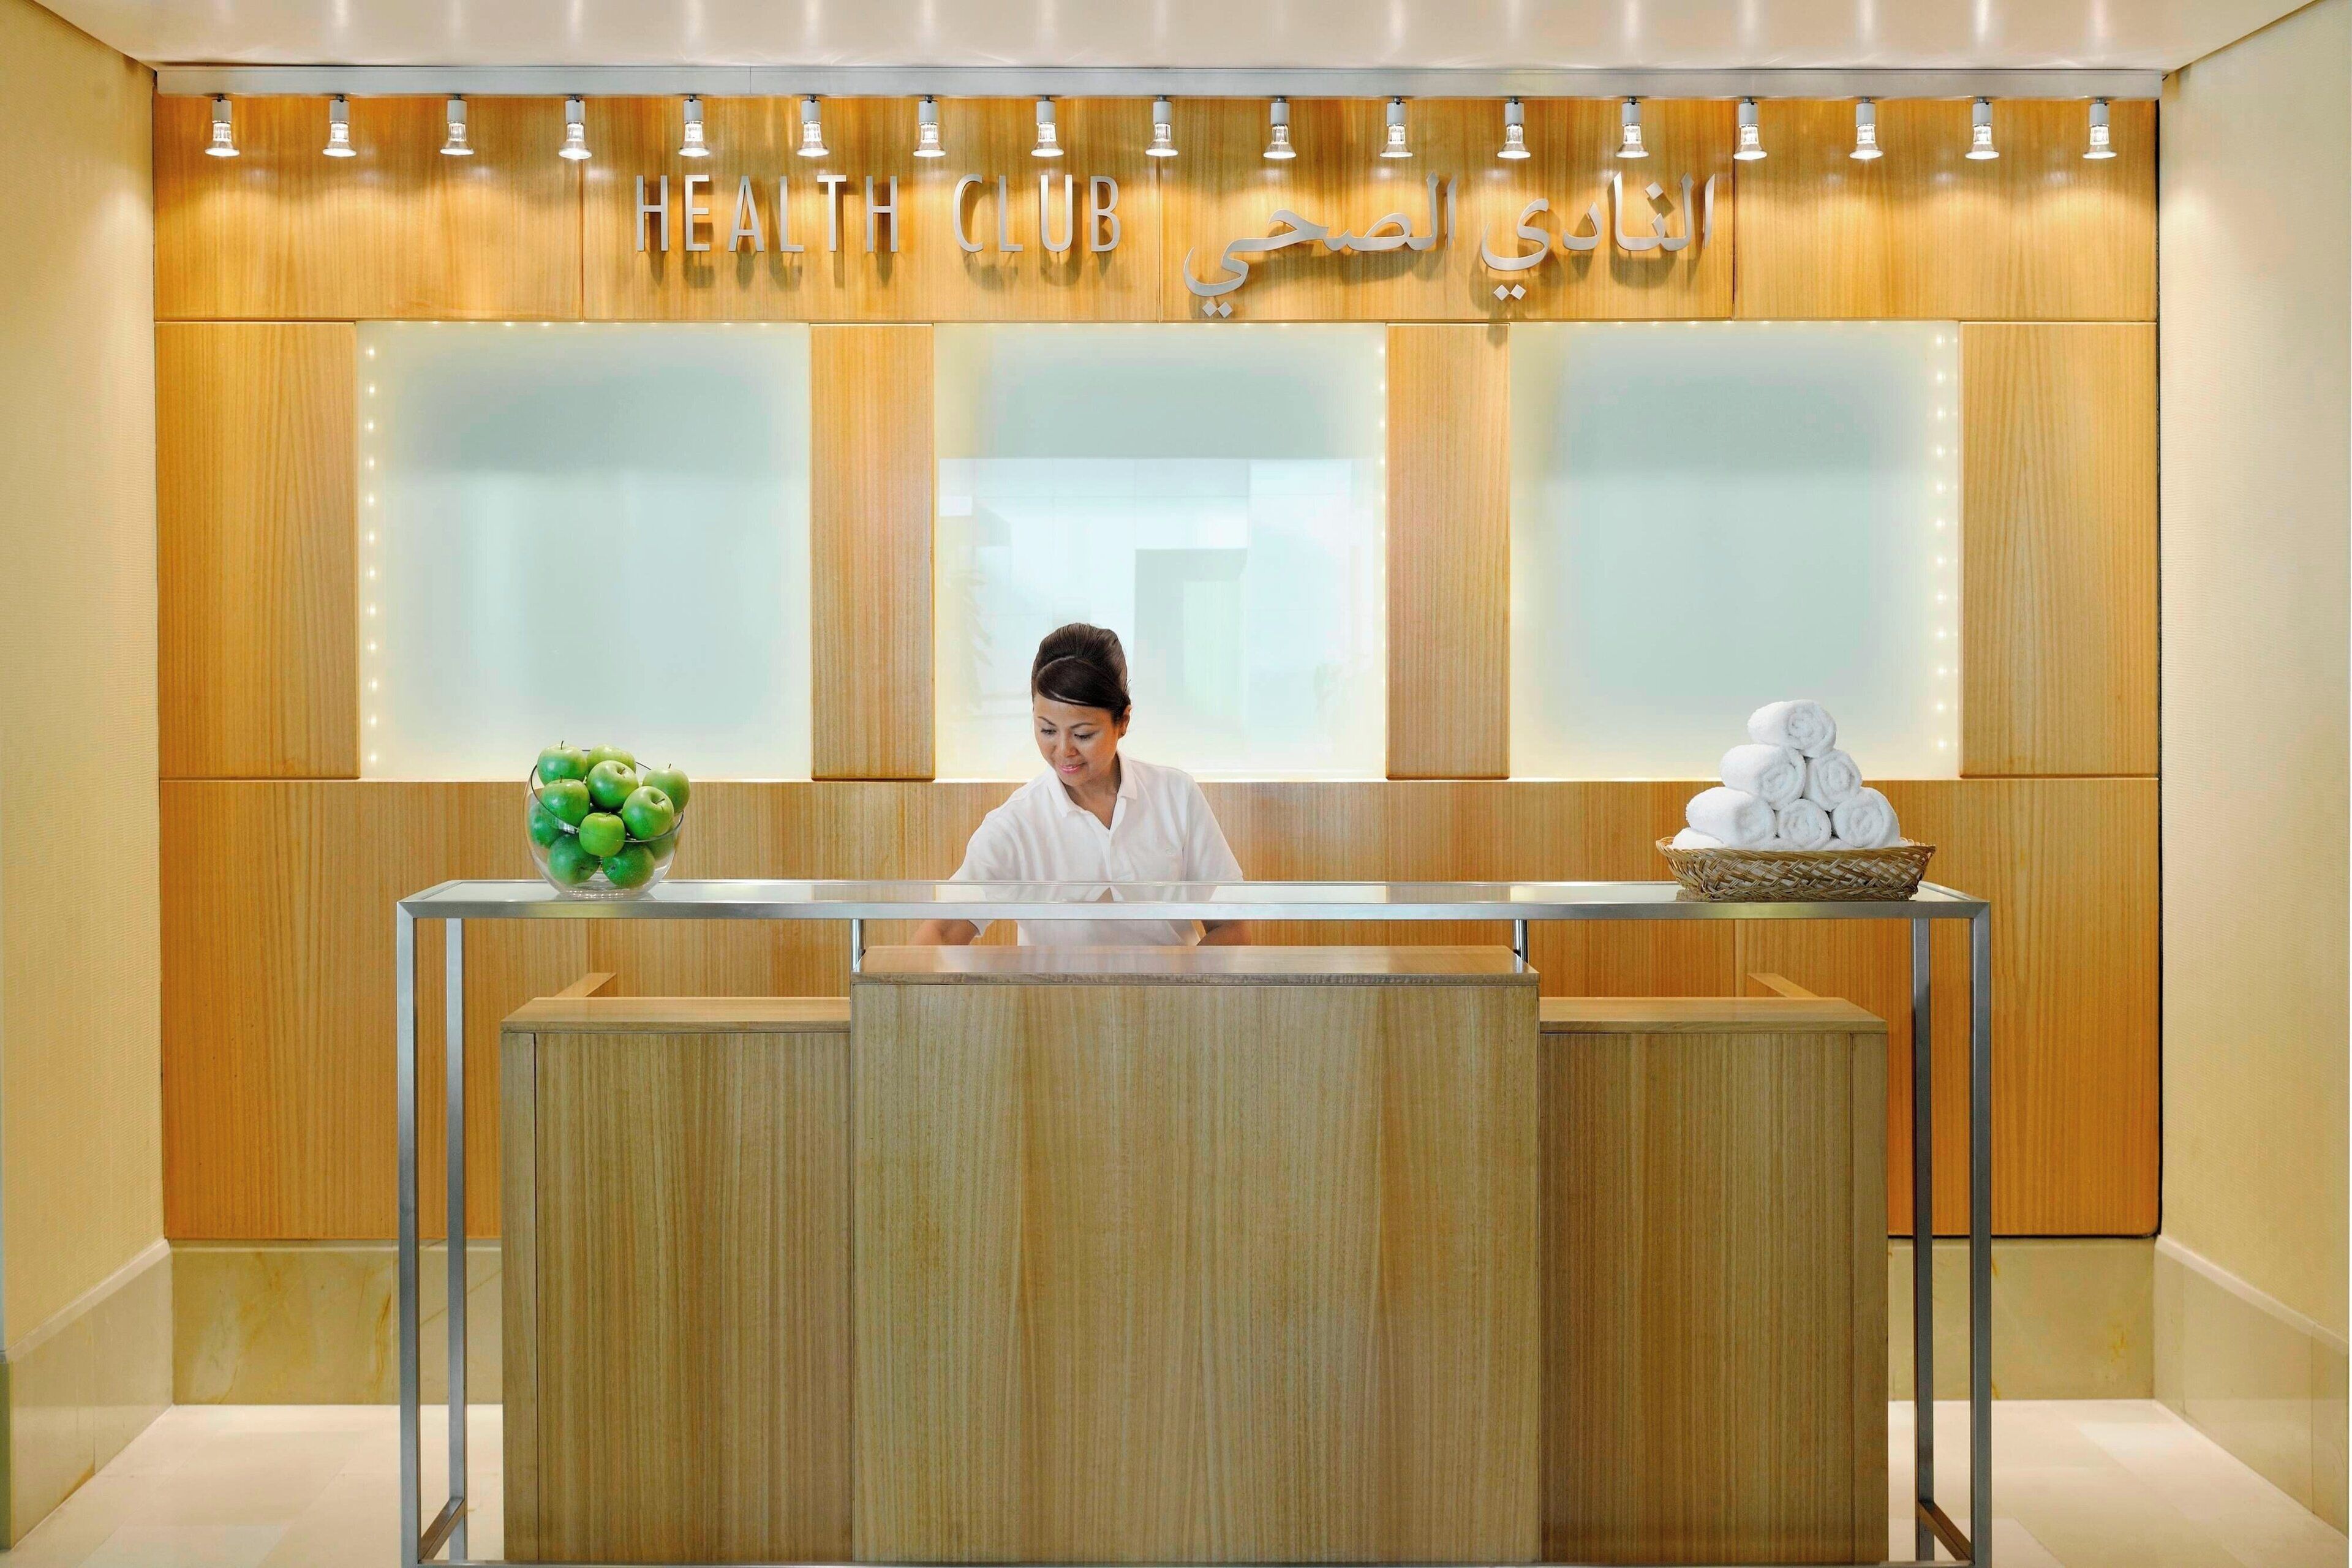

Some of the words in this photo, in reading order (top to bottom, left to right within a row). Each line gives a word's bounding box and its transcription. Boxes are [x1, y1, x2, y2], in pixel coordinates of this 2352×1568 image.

[636, 175, 899, 252] HEALTH
[952, 173, 1121, 252] CLUB
[1183, 171, 1457, 318] الصحي
[1480, 170, 1716, 301] النادي
